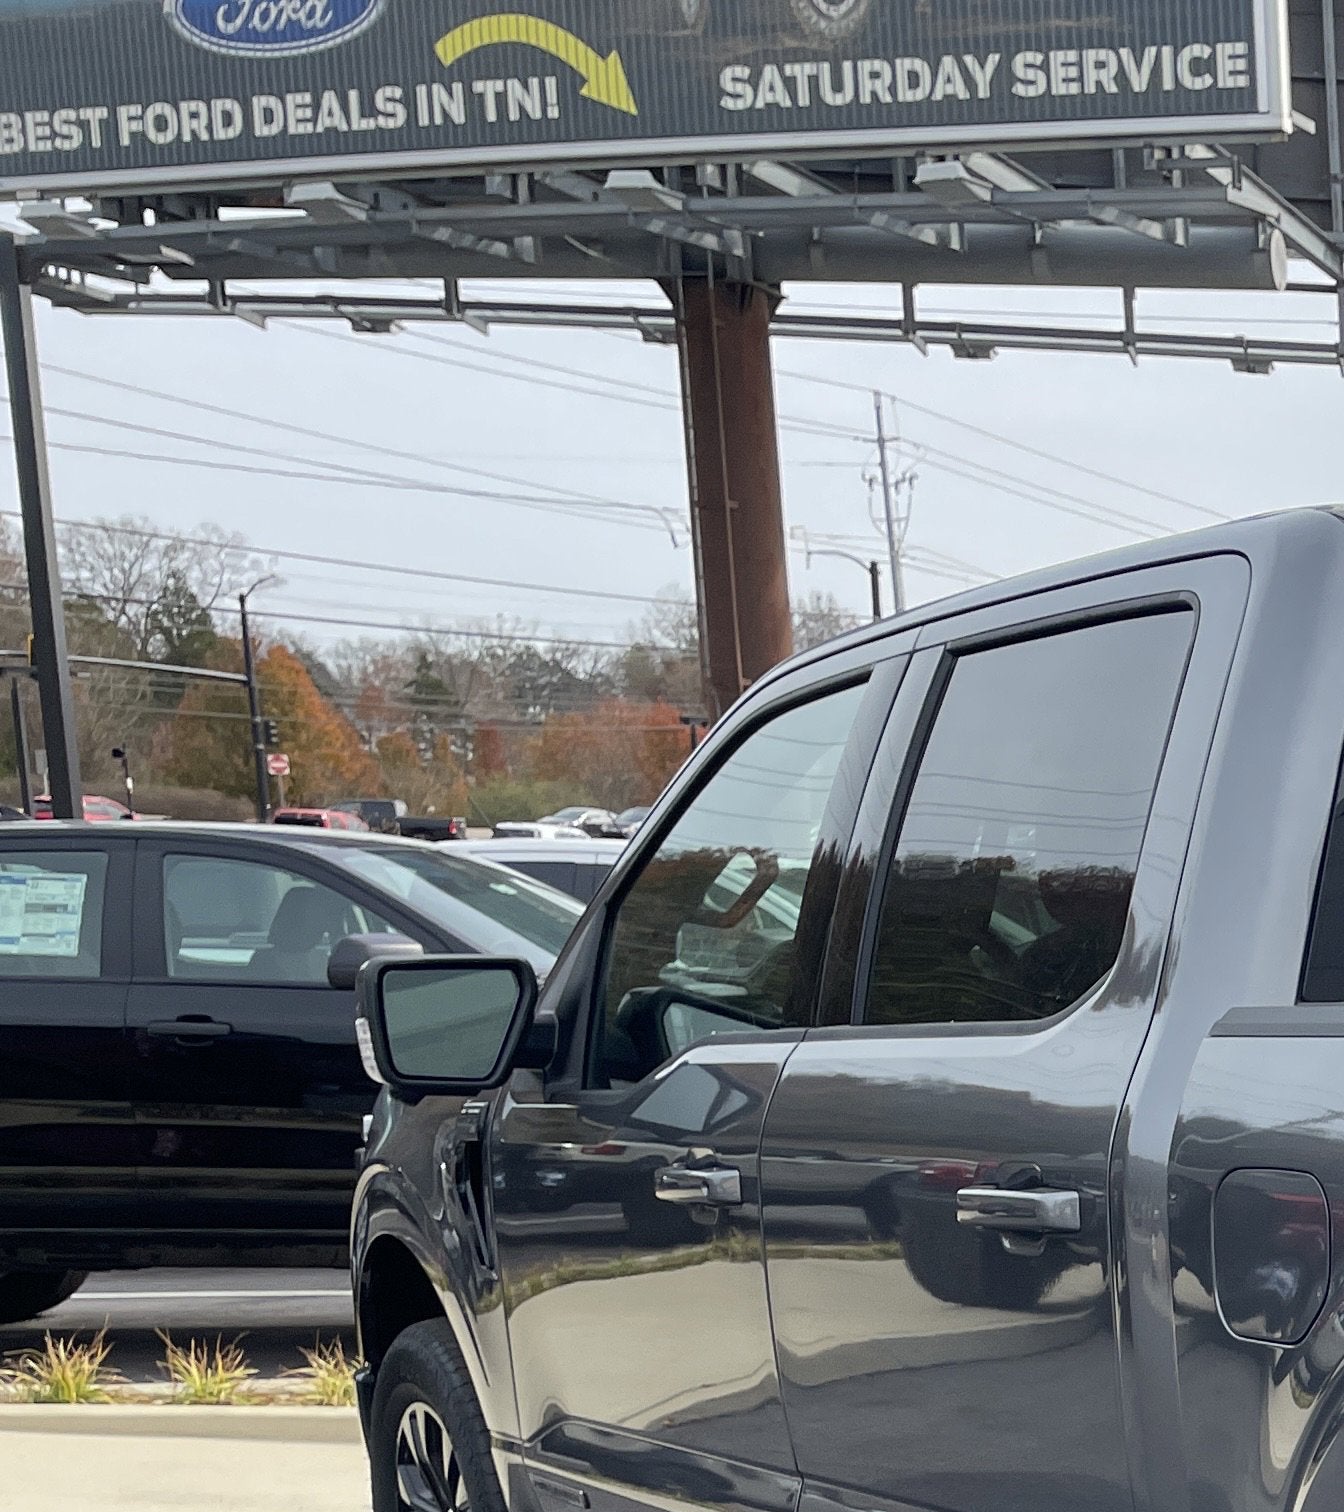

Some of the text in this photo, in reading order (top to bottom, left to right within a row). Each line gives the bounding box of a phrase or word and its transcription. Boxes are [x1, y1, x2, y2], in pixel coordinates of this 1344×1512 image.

[717, 41, 1250, 113] SATURDAY SERVICE
[0, 76, 559, 153] BEST FORD DEALS IN TN!
